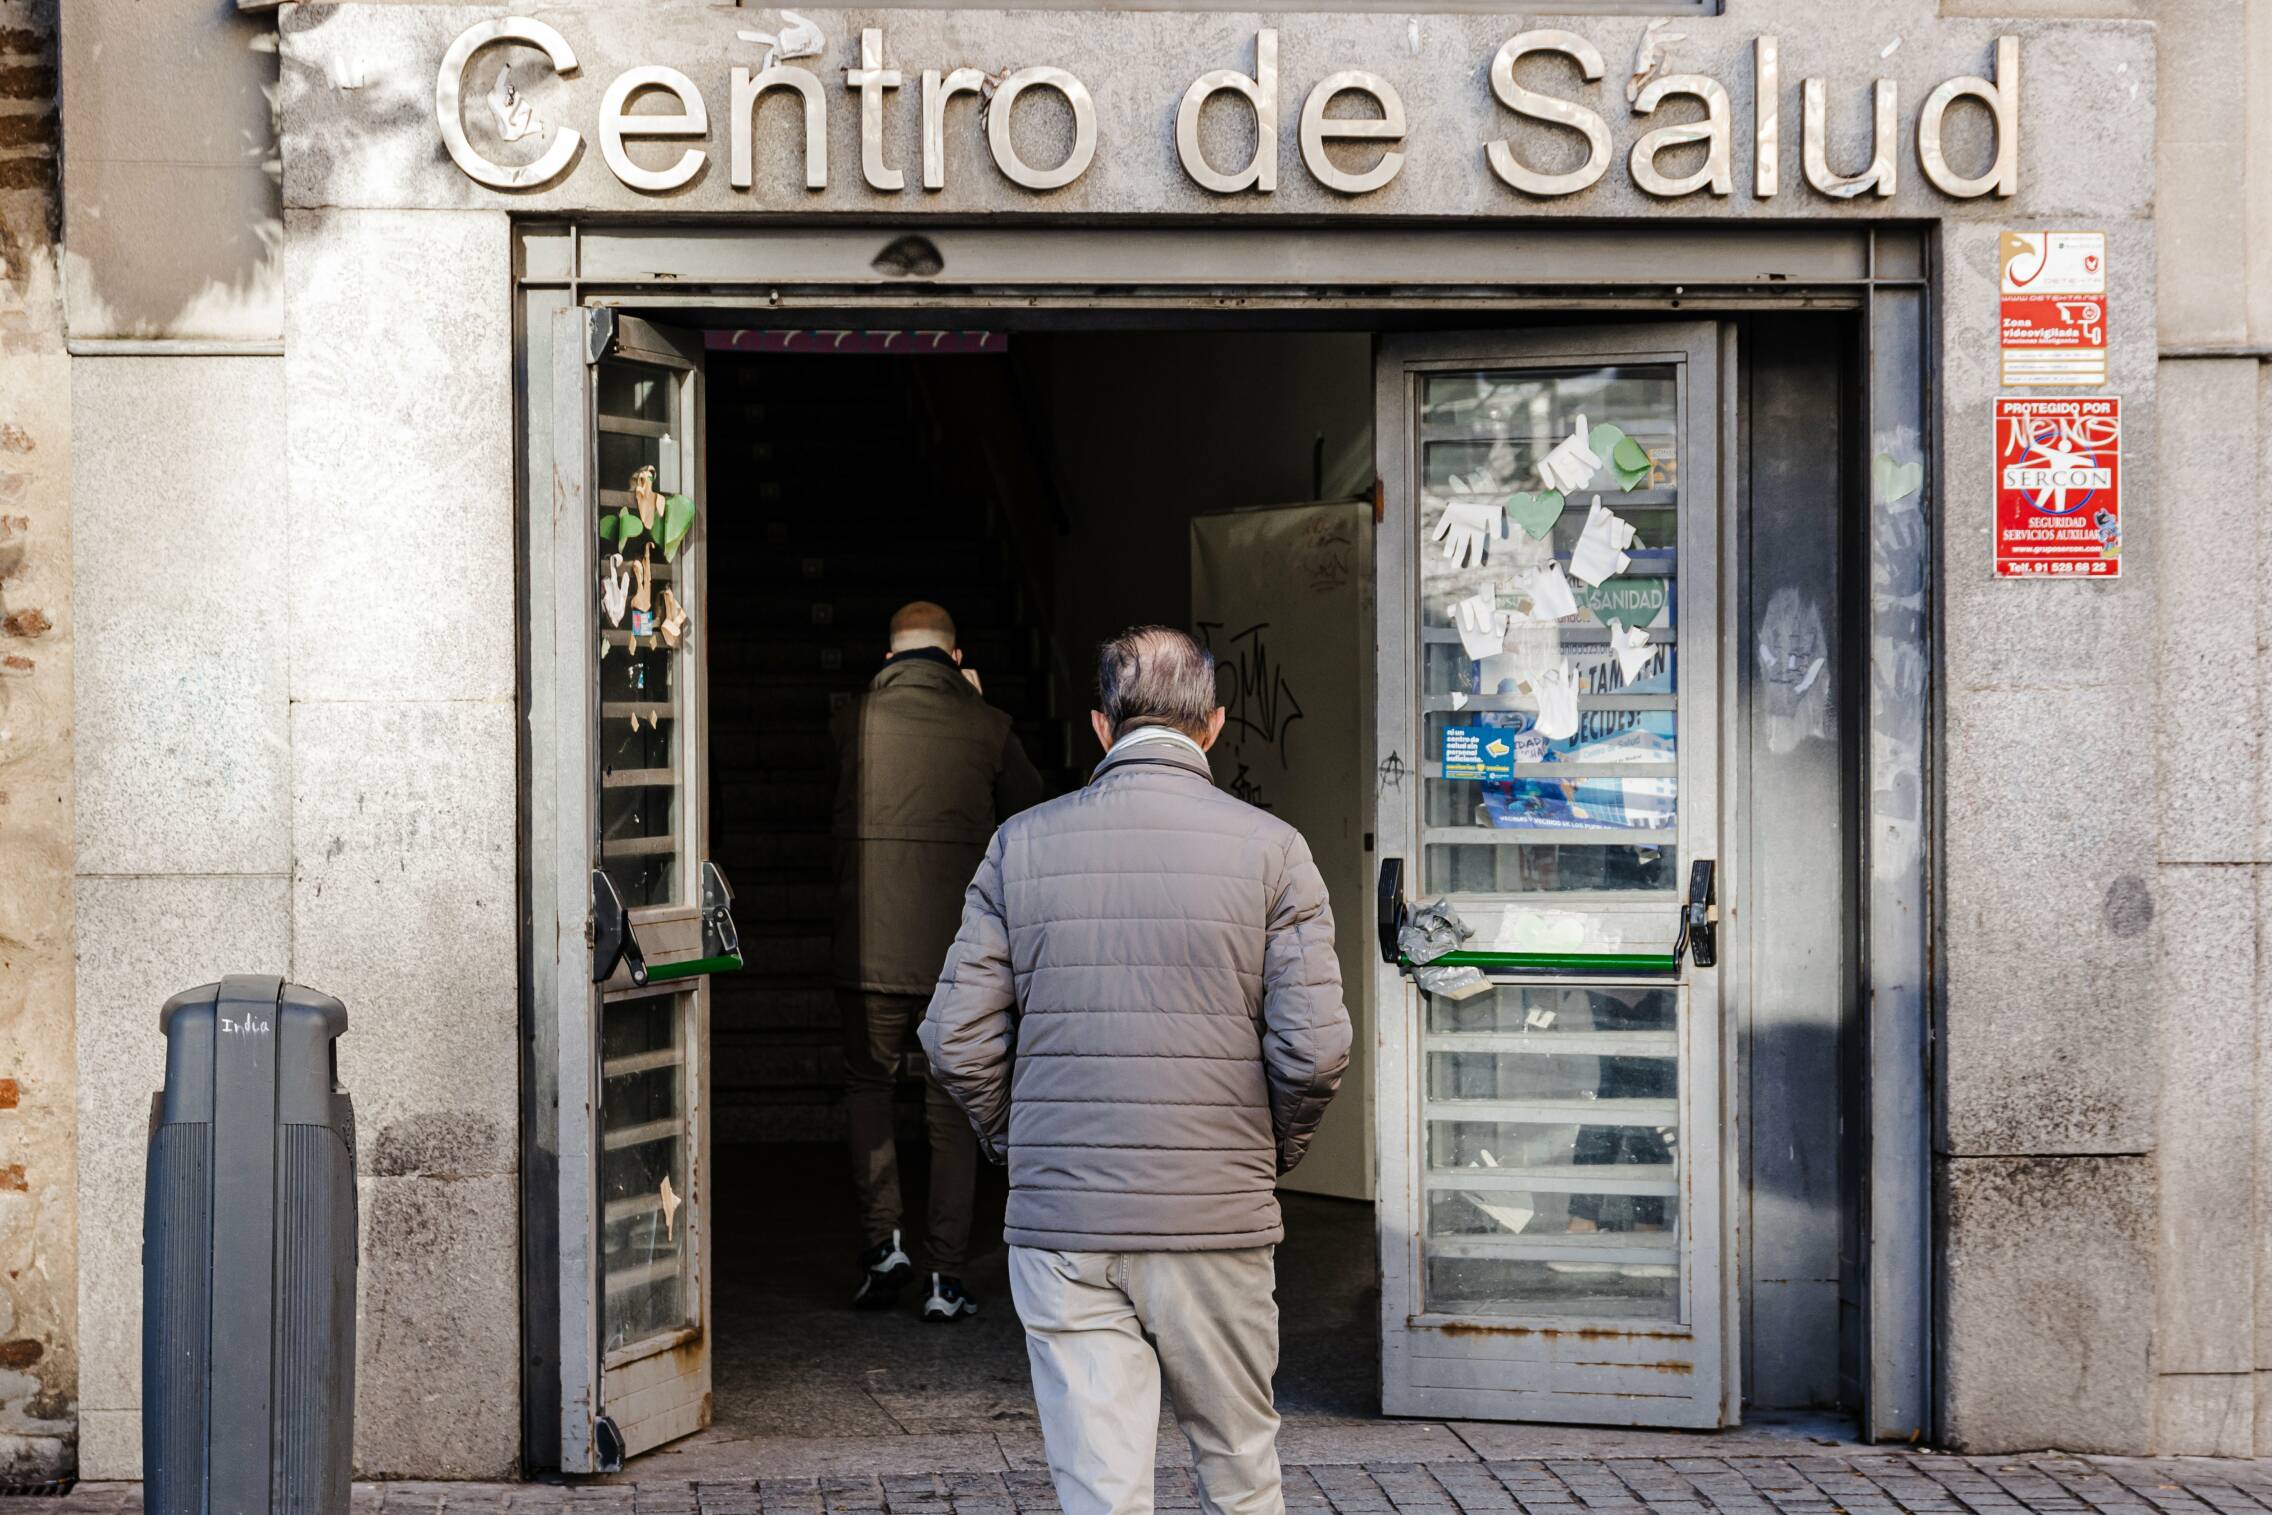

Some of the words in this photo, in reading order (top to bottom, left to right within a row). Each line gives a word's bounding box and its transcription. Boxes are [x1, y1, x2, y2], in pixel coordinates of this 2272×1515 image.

[435, 16, 1098, 191] Centro
[1174, 29, 1407, 194] de
[1484, 28, 2020, 199] Salud
[2003, 318, 2032, 327] Zona
[2003, 328, 2080, 339] videovigilada
[2004, 402, 2080, 414] PROTEGIDO
[2083, 402, 2111, 414] POR
[2006, 470, 2108, 487] SERCON
[2028, 517, 2087, 528] SEGURIDAD
[2003, 529, 2055, 541] SERVICIOS
[2092, 562, 2106, 572] 22
[1590, 589, 1663, 609] SANIDAD
[221, 1013, 270, 1036] India
